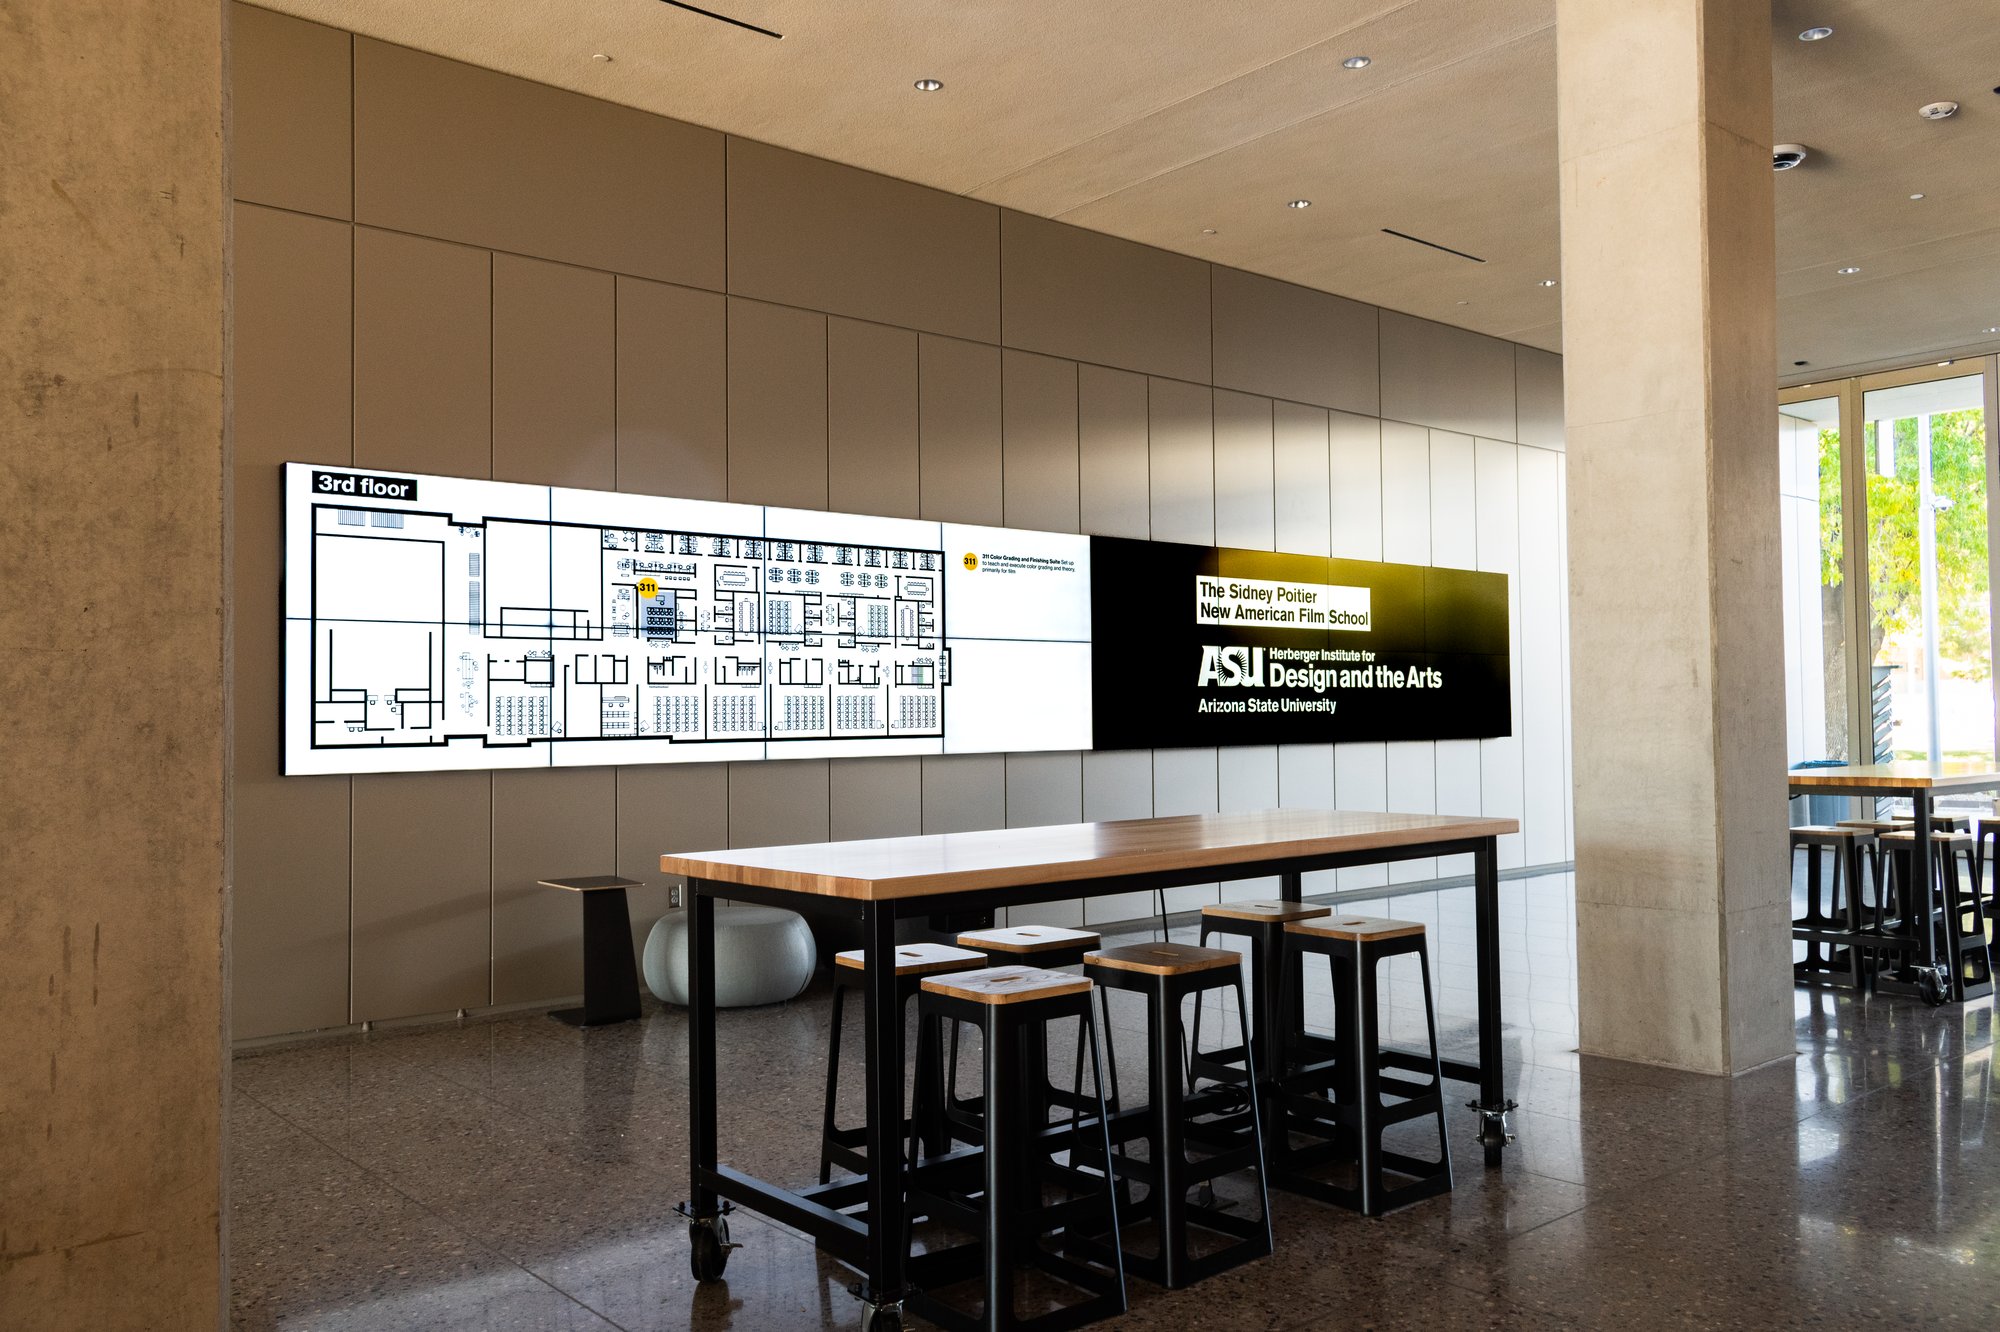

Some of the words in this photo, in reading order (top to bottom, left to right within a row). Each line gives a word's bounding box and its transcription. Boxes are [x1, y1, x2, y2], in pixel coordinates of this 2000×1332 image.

[318, 475, 355, 493] 3rd
[360, 478, 409, 497] floor
[639, 583, 655, 592] 311
[1200, 582, 1225, 597] The
[1229, 585, 1273, 604] Sidney
[1277, 587, 1317, 603] Poitier
[1201, 603, 1230, 619] New
[1235, 605, 1294, 622] American
[1299, 608, 1324, 623] Film
[1329, 610, 1369, 625] School
[1270, 647, 1319, 662] Herberger
[1321, 649, 1360, 661] Institute
[1362, 650, 1375, 661] for
[1198, 645, 1265, 687] ASU
[1270, 663, 1337, 693] Design
[1340, 665, 1373, 688] and
[1376, 666, 1404, 688] the
[1407, 666, 1442, 688] Arts
[1198, 698, 1245, 713] Arizona
[1248, 698, 1279, 712] State
[1281, 698, 1336, 714] University
